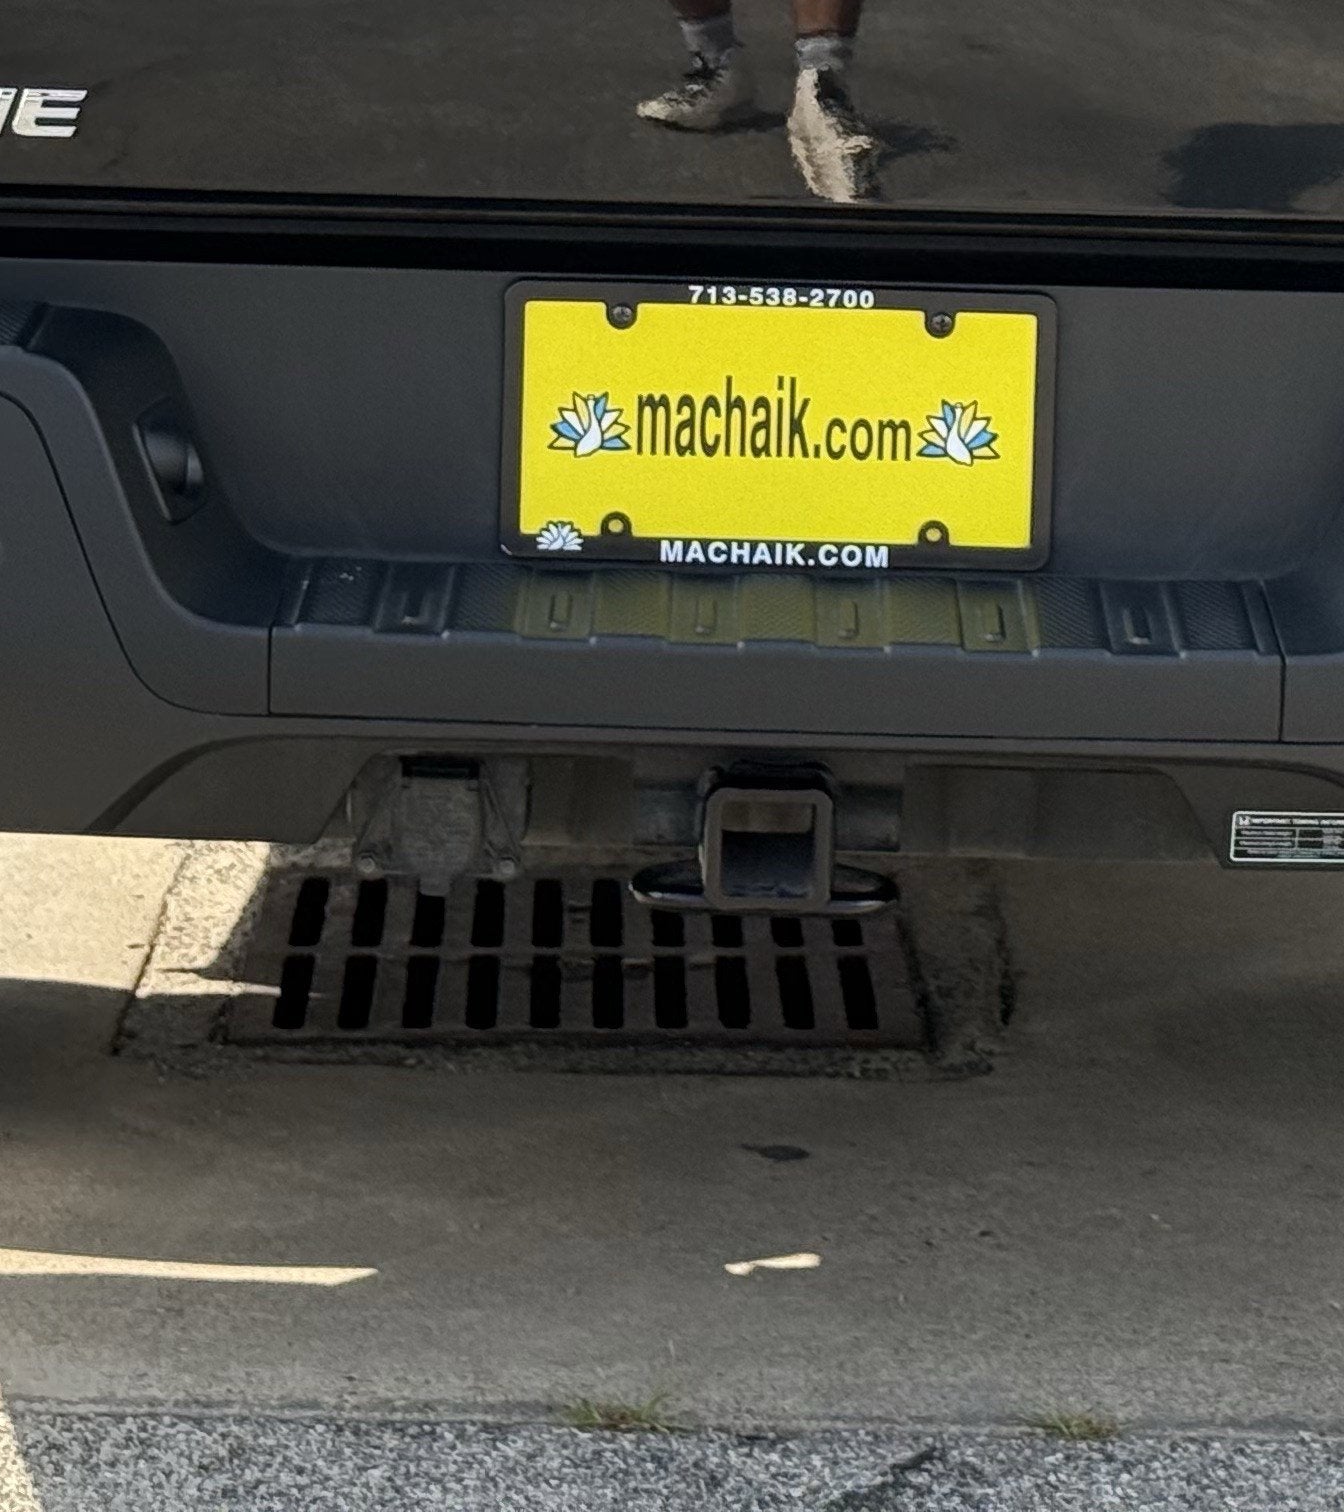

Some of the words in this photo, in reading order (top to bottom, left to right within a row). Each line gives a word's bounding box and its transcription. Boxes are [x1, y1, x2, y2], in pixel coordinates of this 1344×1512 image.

[687, 284, 876, 310] 713-538-2700
[635, 374, 913, 463] machaik.com
[659, 538, 890, 569] MACHAIK.COM
